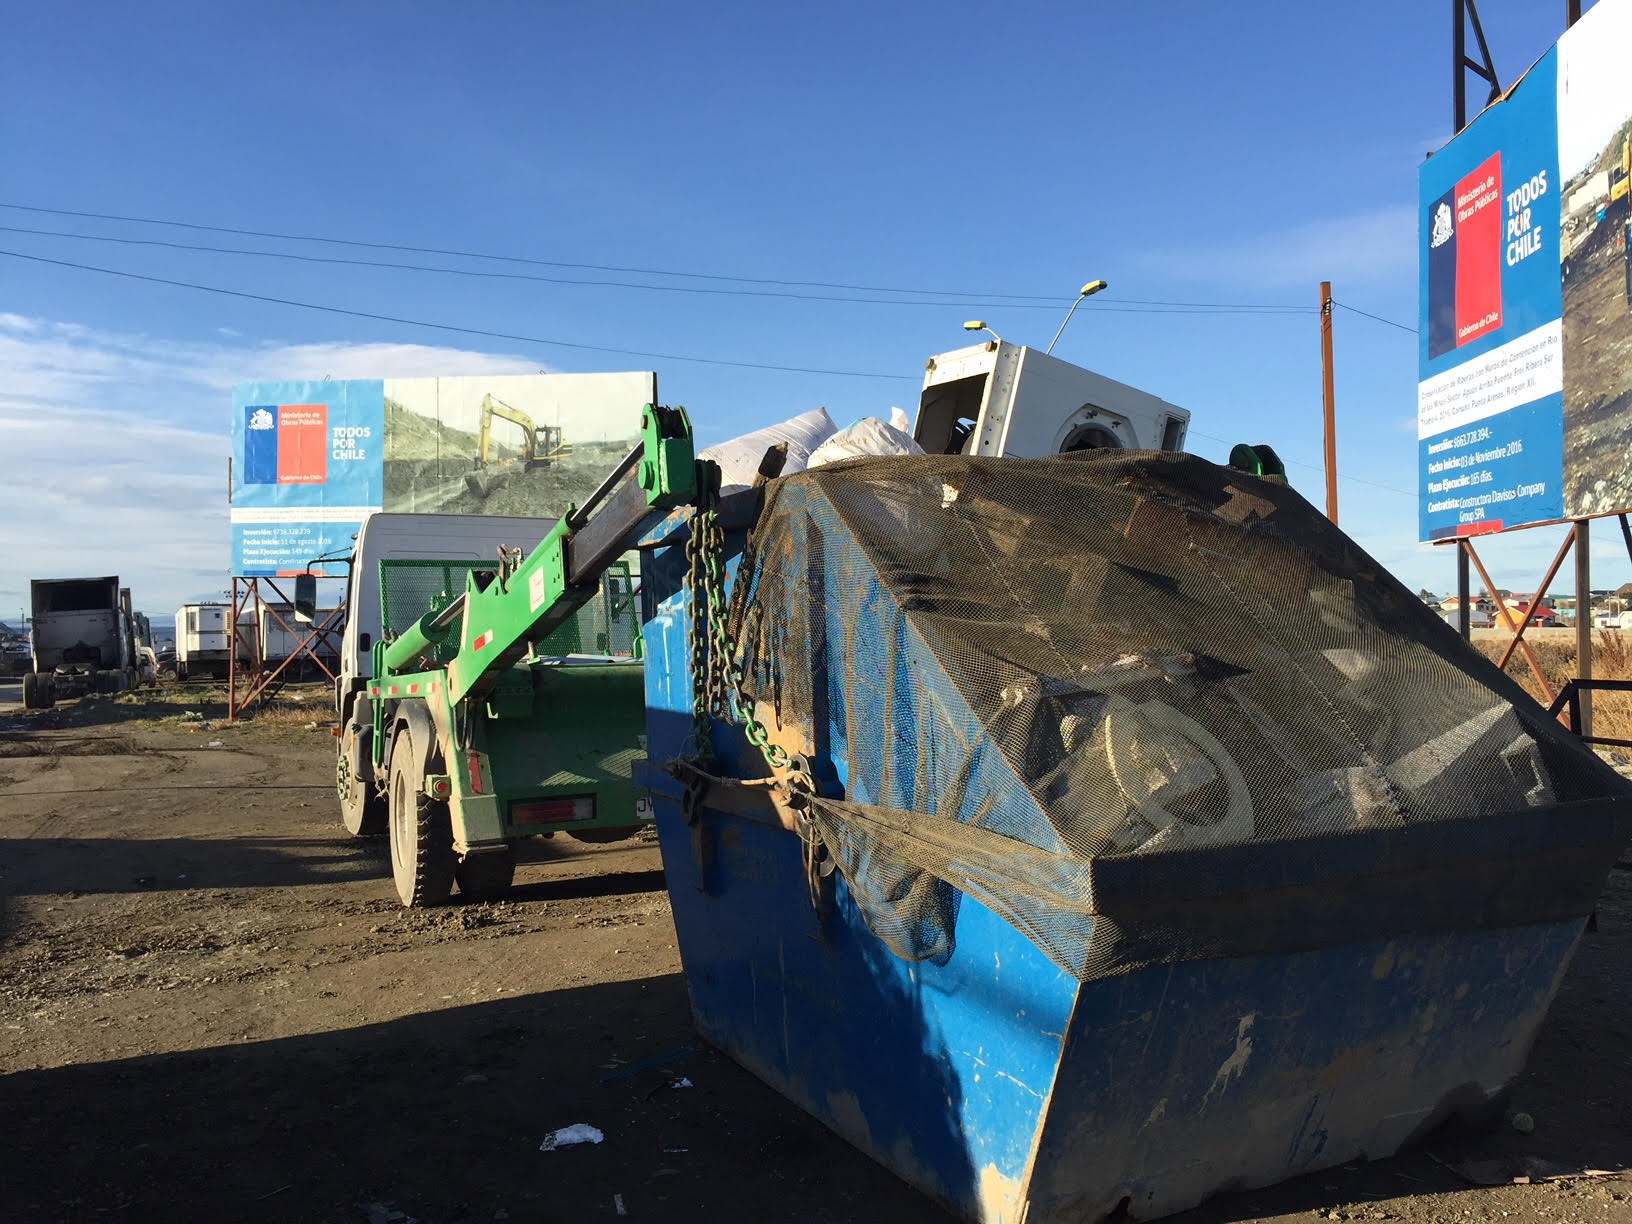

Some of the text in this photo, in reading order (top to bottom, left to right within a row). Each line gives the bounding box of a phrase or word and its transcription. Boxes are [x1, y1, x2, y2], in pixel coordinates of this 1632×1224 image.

[1458, 176, 1495, 209] Ministerio de
[1458, 189, 1499, 223] Obras Públicas
[1507, 170, 1547, 216] TODOS
[1507, 208, 1531, 242] POR
[1507, 225, 1542, 267] CHILE
[1458, 311, 1499, 338] Gobierno de Chile
[1501, 358, 1508, 368] de
[1539, 340, 1546, 350] en
[1462, 385, 1477, 398] Aguas
[1478, 378, 1493, 390] Arriba
[1493, 372, 1512, 385] Puente
[1514, 366, 1524, 376] Frei
[1525, 360, 1543, 372] Ribera
[1543, 353, 1553, 365] Sur
[1471, 398, 1486, 408] Punta
[299, 418, 323, 426] Públicas
[332, 427, 371, 438] TODOS
[332, 438, 356, 449] POR
[332, 449, 366, 460] CHILE
[1428, 439, 1454, 455] Inversión:
[1428, 463, 1443, 474] Fecha
[1443, 456, 1460, 471] Inicio:
[1460, 458, 1468, 468] 03
[1469, 455, 1475, 465] de
[1475, 447, 1506, 464] Noviembre
[1428, 482, 1442, 494] Plazo
[1443, 475, 1470, 493] Ejecución:
[1428, 498, 1460, 513] Contratista:
[1460, 494, 1492, 509] Constructora
[1517, 482, 1546, 498] Company
[1460, 507, 1485, 523] Group SPA
[243, 528, 272, 536] Inversión:
